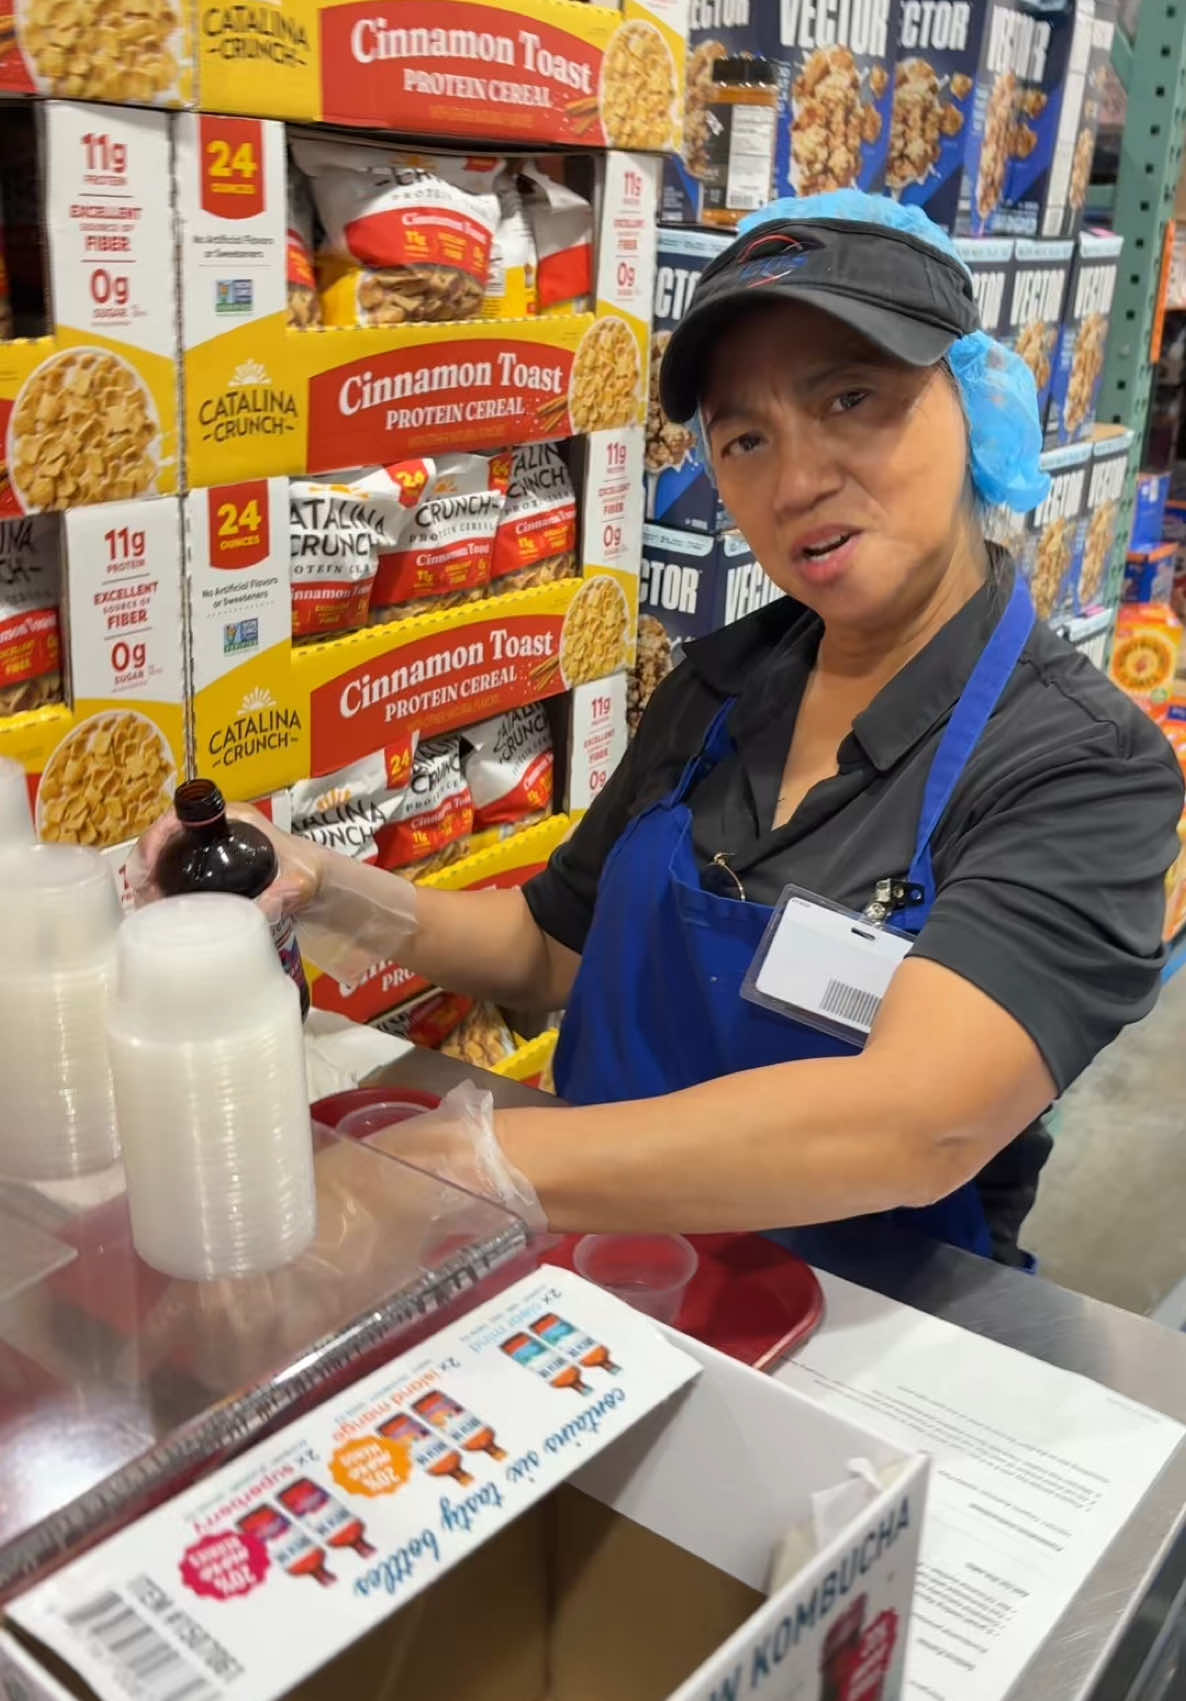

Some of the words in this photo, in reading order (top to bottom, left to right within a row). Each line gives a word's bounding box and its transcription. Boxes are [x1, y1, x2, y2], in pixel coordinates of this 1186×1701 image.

[202, 5, 310, 51] CATALINA
[779, 0, 890, 57] VECTOR
[352, 18, 514, 66] Cinnamon
[519, 31, 592, 95] Toast
[403, 68, 487, 100] PROTEIN
[487, 79, 553, 108] CEREAL
[81, 133, 127, 173] 11g
[207, 139, 257, 178] 24
[69, 204, 142, 220] EXCELLENT
[85, 235, 131, 252] FIBER
[90, 268, 129, 305] 0g
[339, 359, 492, 416] Cinnamon
[497, 352, 563, 393] Toast
[199, 390, 298, 426] CATALINA
[386, 405, 462, 430] PROTEIN
[465, 397, 525, 425] CEREAL
[215, 416, 285, 443] CRUNCH
[606, 441, 627, 466] 11g
[217, 500, 261, 535] 24
[415, 495, 491, 527] CRUNCH
[104, 526, 146, 561] 11g
[602, 525, 622, 547] 0g
[106, 558, 146, 574] PROTEIN
[93, 581, 159, 606] EXCELLENT
[107, 610, 148, 630] FIBER
[111, 641, 147, 672] 0g
[340, 644, 485, 719] Cinnamon
[490, 629, 553, 667] Toast
[114, 671, 144, 684] SUGAR
[384, 684, 459, 722] PROTEIN
[461, 664, 518, 699] CEREAL
[591, 697, 611, 719] 11g
[208, 708, 302, 756] CATALINA
[222, 731, 290, 767] CRUNCH
[390, 748, 410, 775] 24
[542, 1287, 562, 1304] 2x
[440, 1357, 460, 1371] 2x
[391, 1366, 439, 1405] island
[333, 1401, 390, 1442] mango
[543, 1388, 626, 1453] contains
[297, 1447, 320, 1466] 2x
[505, 1448, 541, 1481] six
[192, 1463, 294, 1535] superberry
[440, 1480, 504, 1530] tasty
[213, 1564, 257, 1594] 20%
[353, 1529, 439, 1598] bottles
[751, 1495, 910, 1689] KOMBUCHA
